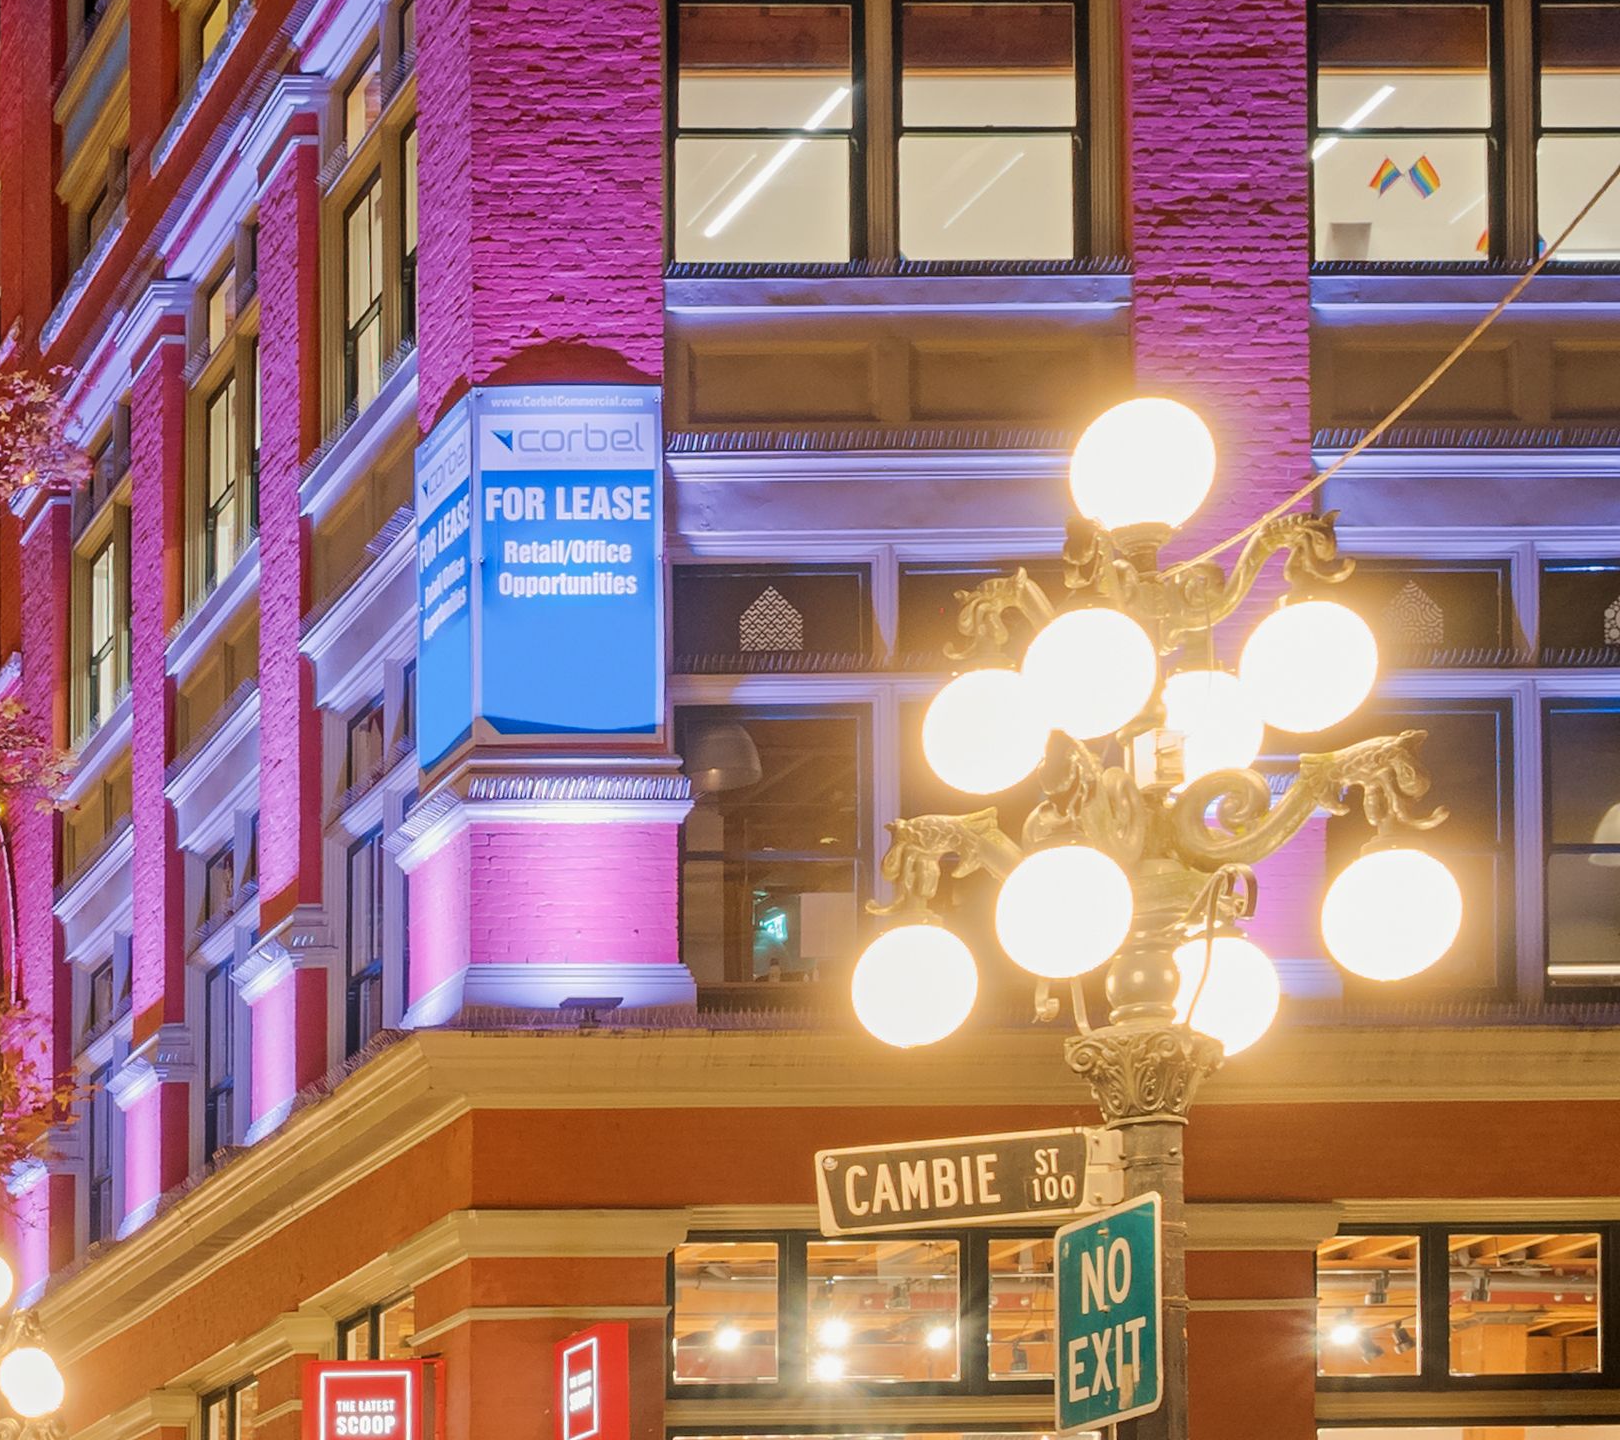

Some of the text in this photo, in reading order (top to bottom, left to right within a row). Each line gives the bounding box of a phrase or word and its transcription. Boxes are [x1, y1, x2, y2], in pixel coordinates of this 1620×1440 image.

[491, 394, 643, 408] www.CorbelCommercial.com
[518, 422, 645, 453] corbel
[485, 486, 651, 521] FOR LEASE
[419, 492, 470, 574] FOR LEASE
[504, 539, 633, 565] Retail/Office
[498, 571, 638, 598] Opportunities
[844, 1148, 1061, 1217] CAMBIE ST
[1031, 1173, 1077, 1204] 100
[1080, 1236, 1133, 1316] NO
[1068, 1315, 1147, 1404] EXIT
[335, 1399, 396, 1412] THE LATEST
[335, 1415, 396, 1435] SCOOP
